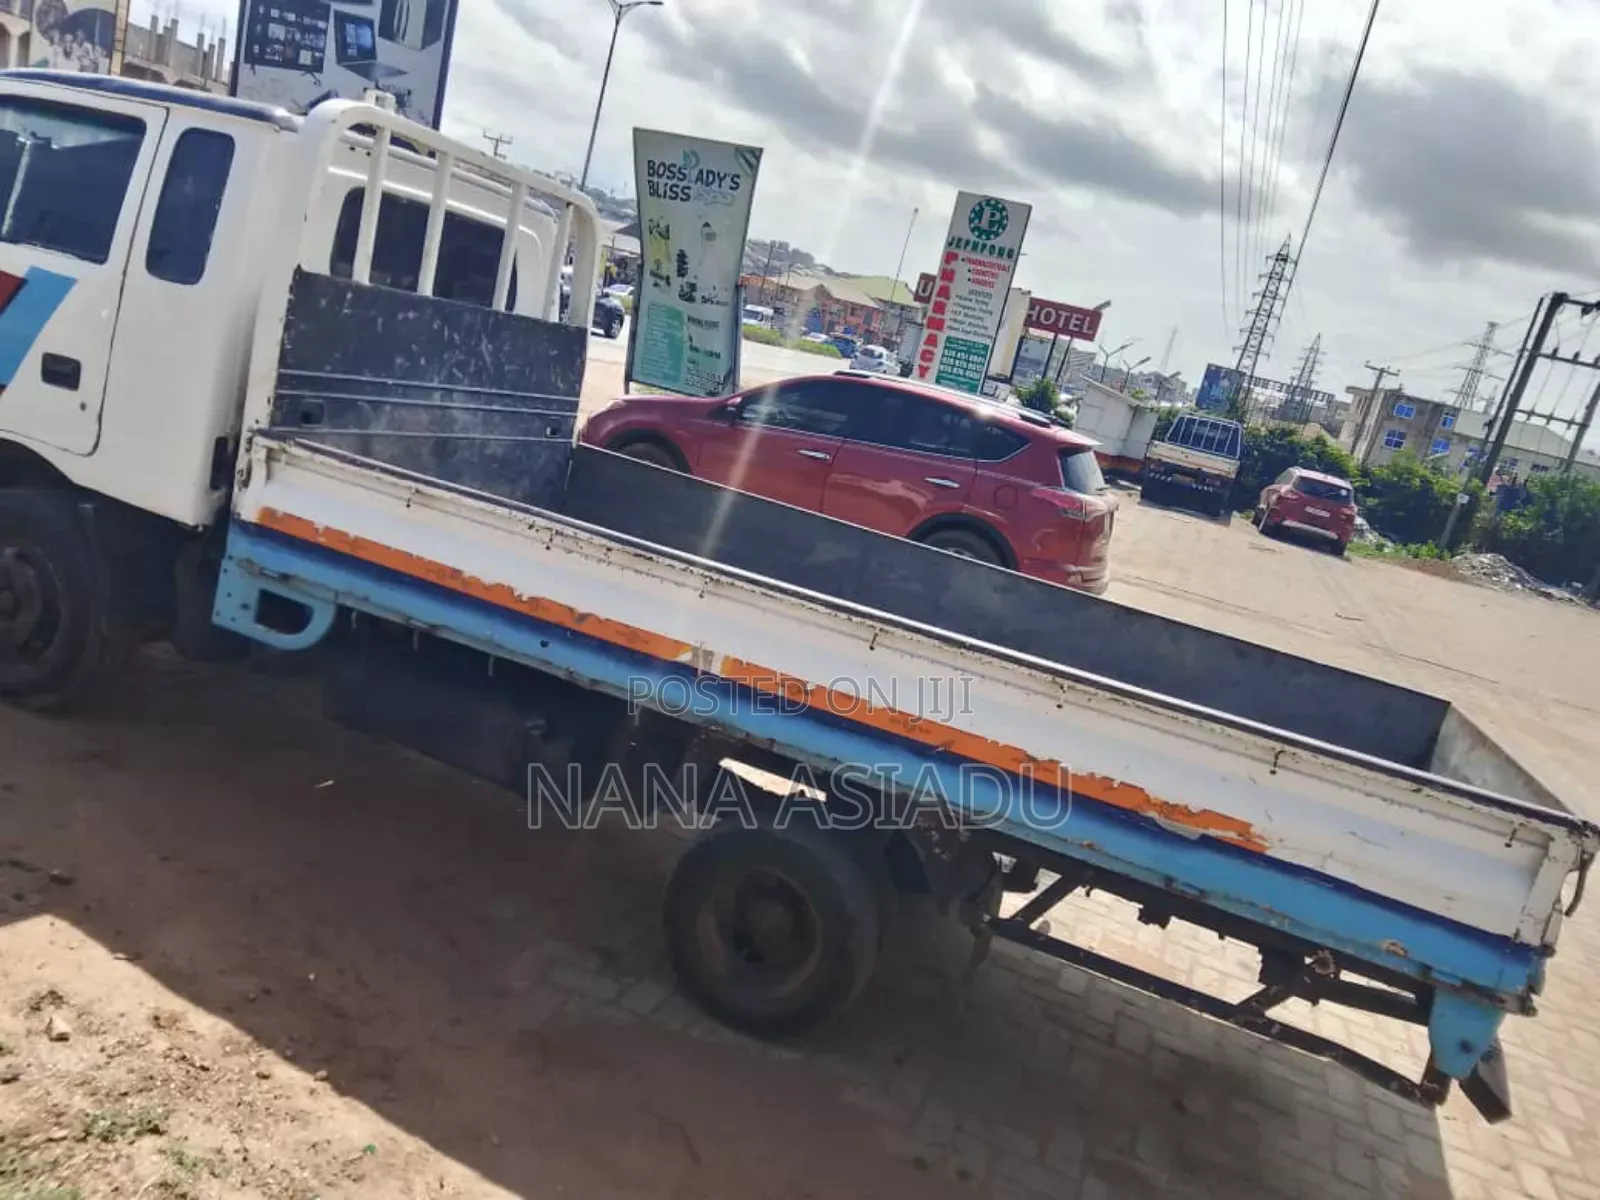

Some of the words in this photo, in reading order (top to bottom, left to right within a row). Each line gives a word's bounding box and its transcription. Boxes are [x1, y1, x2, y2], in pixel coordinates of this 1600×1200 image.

[647, 159, 688, 182] BOSS
[917, 251, 959, 379] PHARMACY
[1027, 304, 1095, 335] HOTEL
